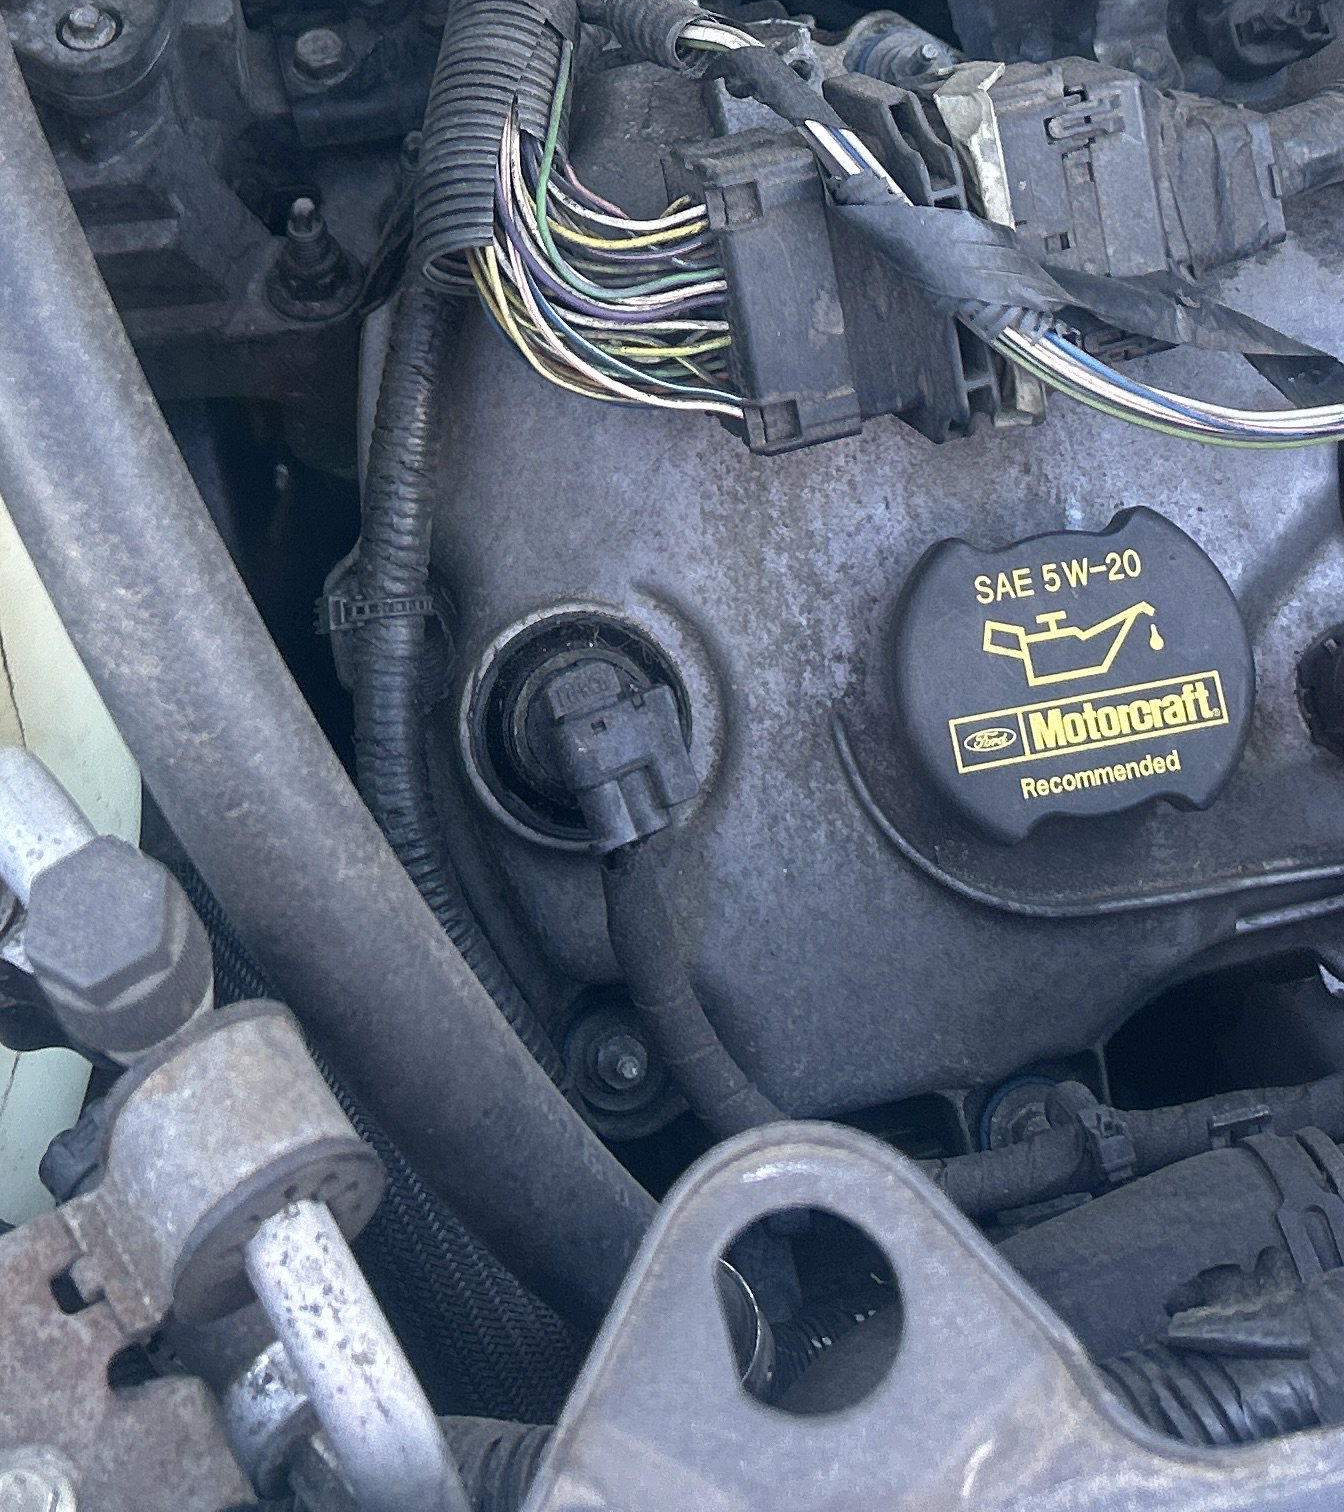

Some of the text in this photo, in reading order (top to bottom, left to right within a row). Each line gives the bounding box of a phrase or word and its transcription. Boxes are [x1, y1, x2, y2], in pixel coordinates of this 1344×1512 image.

[974, 568, 1035, 605] SAE
[973, 730, 1009, 749] Ford
[1021, 750, 1182, 799] Recommended
